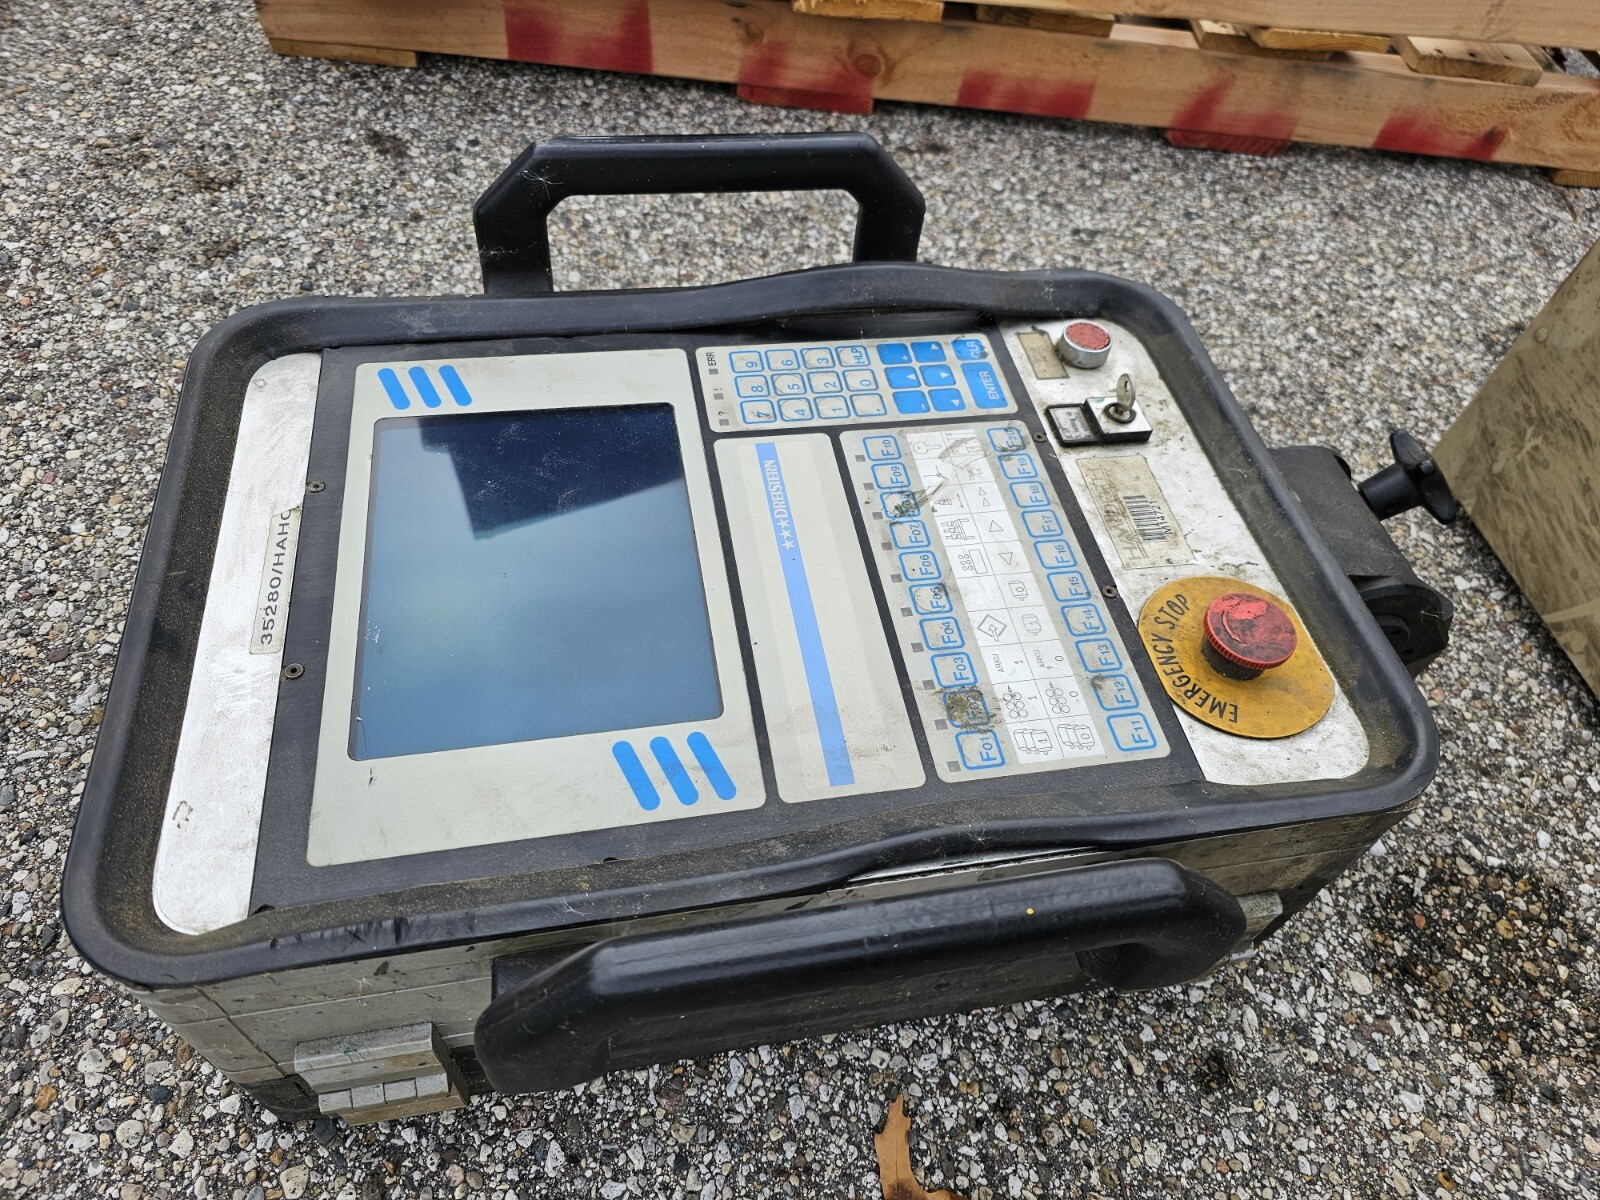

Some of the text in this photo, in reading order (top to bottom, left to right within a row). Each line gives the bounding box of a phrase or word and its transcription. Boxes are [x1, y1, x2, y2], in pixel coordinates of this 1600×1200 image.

[706, 352, 717, 367] ERR
[851, 348, 865, 365] HLP
[751, 385, 764, 393] 8
[787, 383, 800, 391] 5
[859, 379, 872, 387] 0
[980, 370, 1000, 400] ENTER
[794, 408, 807, 416] 4
[881, 439, 895, 457] F10
[890, 465, 904, 485] F09
[1017, 458, 1032, 475] F19
[763, 459, 788, 519] DREISTERN
[1029, 485, 1044, 503] F18
[1042, 514, 1056, 533] F17
[1150, 501, 1173, 535] M14721
[909, 524, 924, 544] F07
[1054, 544, 1070, 564] F16
[919, 554, 935, 576] F06
[1068, 576, 1084, 596] F15
[930, 586, 945, 610] F05
[1083, 609, 1099, 631] F14
[941, 621, 957, 645] F04
[992, 653, 1005, 673] ARKU
[1033, 650, 1045, 668] ARKU
[1098, 644, 1115, 667] F13
[1150, 593, 1238, 723] EMERGENCY STOP
[953, 656, 970, 682] F03
[1114, 680, 1131, 705] F12
[1131, 720, 1149, 744] F11
[979, 737, 997, 763] F01
